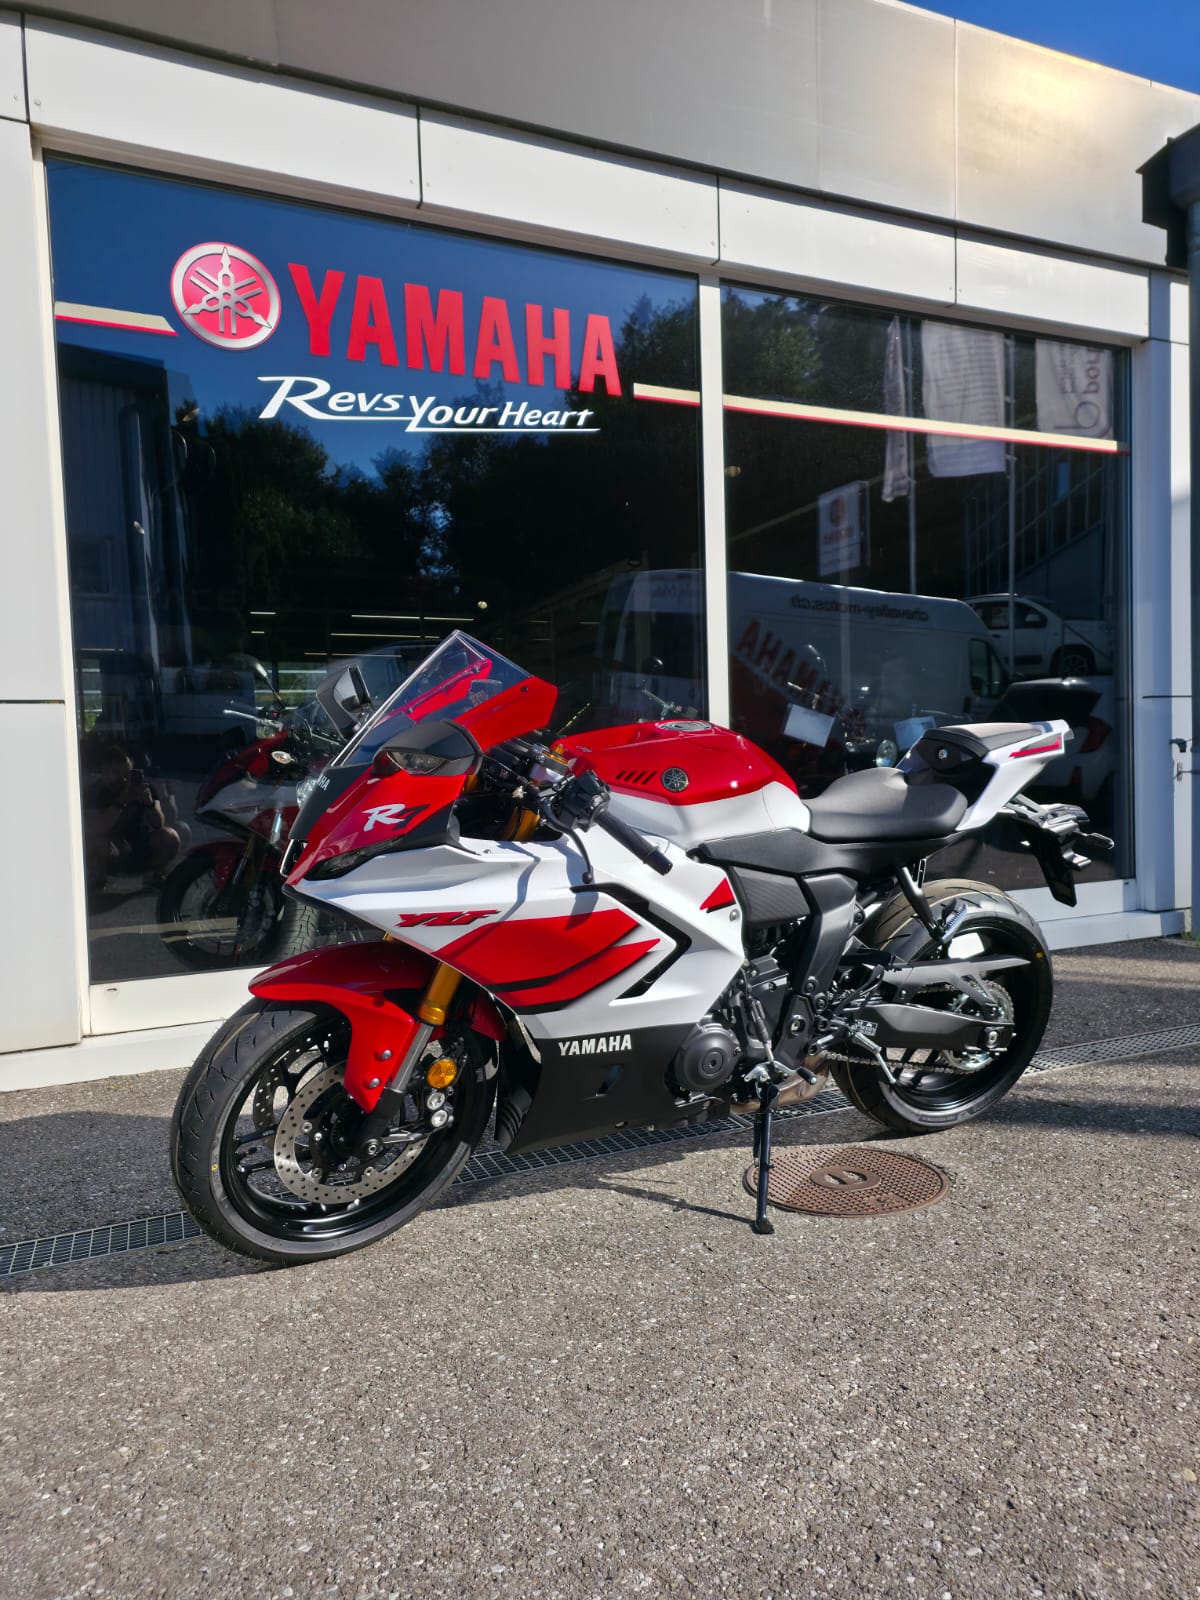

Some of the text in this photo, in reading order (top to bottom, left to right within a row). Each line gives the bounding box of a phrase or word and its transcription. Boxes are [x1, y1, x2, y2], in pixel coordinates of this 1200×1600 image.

[288, 262, 622, 397] YAMAHA
[257, 376, 594, 432] Revs Your Heart
[361, 803, 432, 832] R7
[394, 909, 501, 928] YZF
[558, 1033, 632, 1057] YAMAHA
